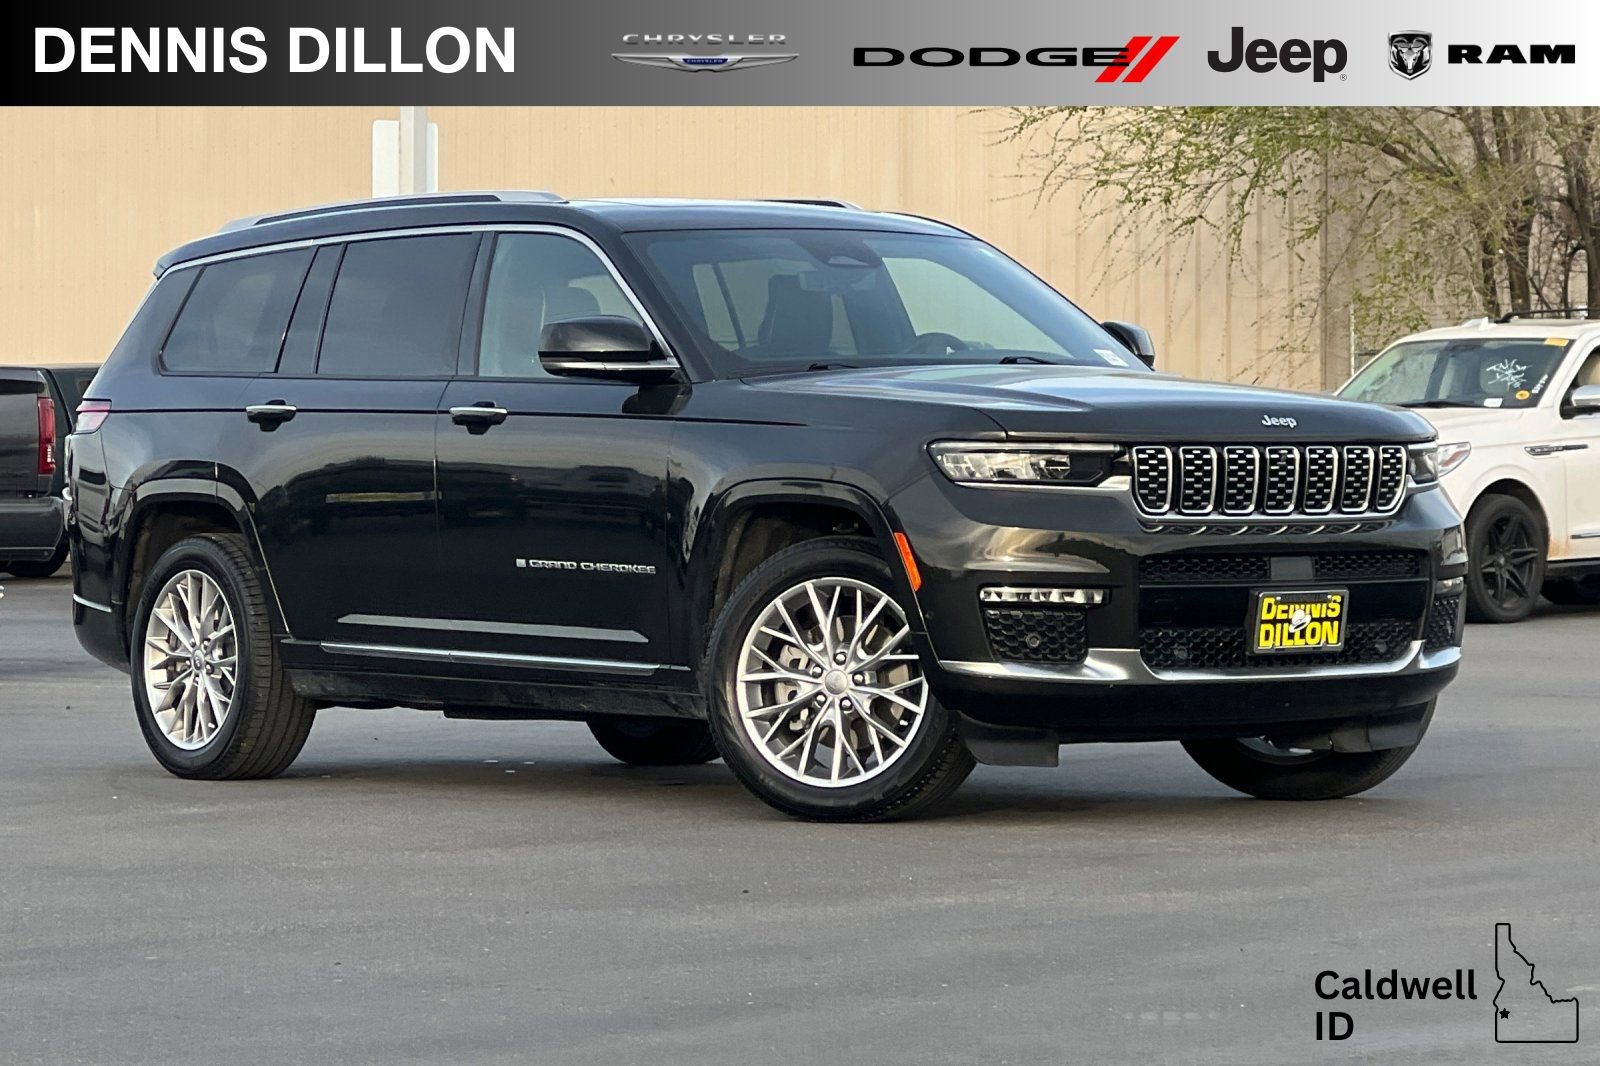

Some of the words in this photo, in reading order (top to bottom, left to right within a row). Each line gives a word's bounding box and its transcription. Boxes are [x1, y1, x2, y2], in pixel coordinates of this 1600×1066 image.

[1261, 414, 1297, 428] Jeep
[529, 559, 577, 570] GRAND
[580, 561, 656, 574] CHEROKEE
[1259, 620, 1340, 648] DILLON
